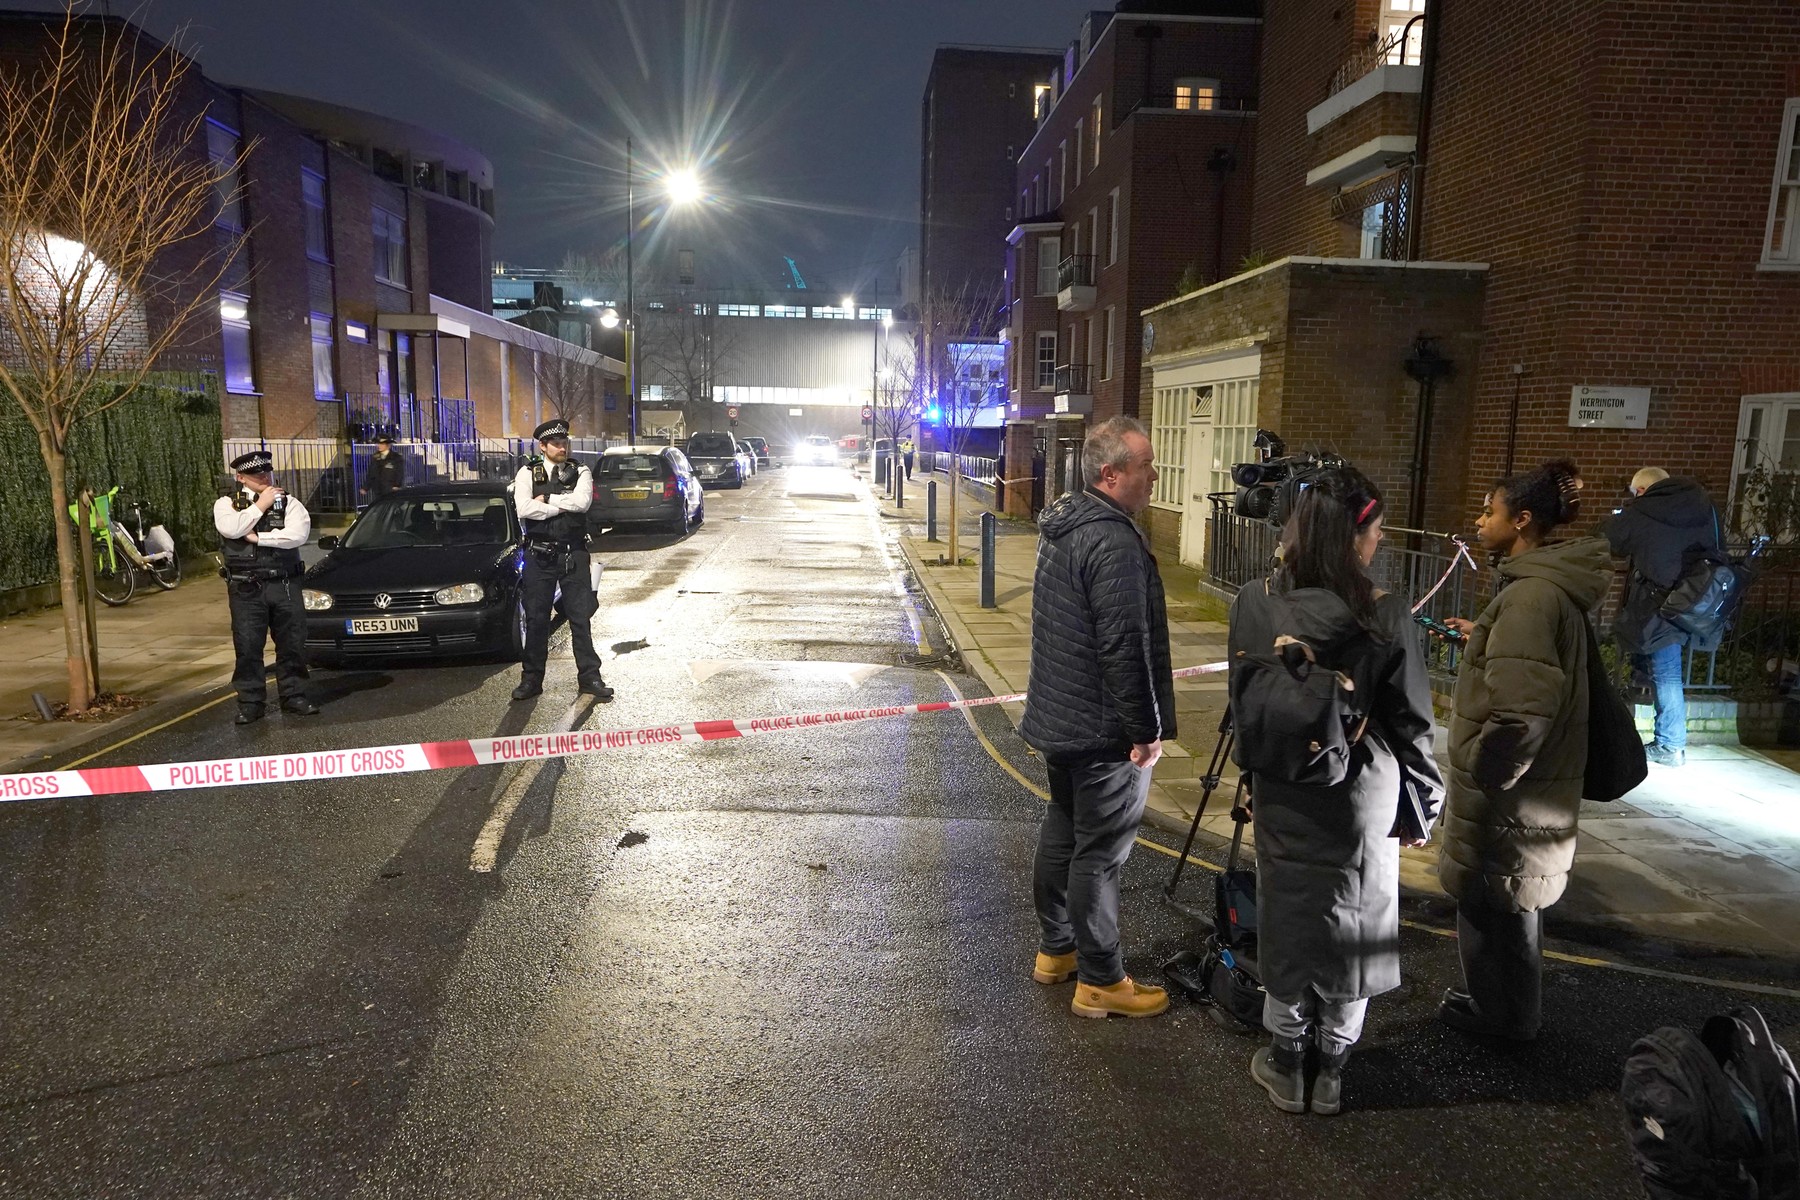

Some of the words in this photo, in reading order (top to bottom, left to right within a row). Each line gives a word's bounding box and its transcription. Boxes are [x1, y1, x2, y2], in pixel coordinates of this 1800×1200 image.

[1578, 410, 1604, 420] STREET
[354, 620, 387, 632] RE53
[390, 618, 416, 631] UNN
[796, 714, 822, 728] LINE
[492, 737, 543, 760] POLICE
[547, 734, 580, 755] LINE
[583, 732, 603, 751] DO
[606, 730, 634, 748] NOT
[636, 726, 682, 745] CROSS
[169, 763, 233, 786] POLICE
[239, 759, 278, 782] LINE
[283, 757, 307, 778] DO
[312, 754, 346, 776] NOT
[351, 749, 405, 772] CROSS
